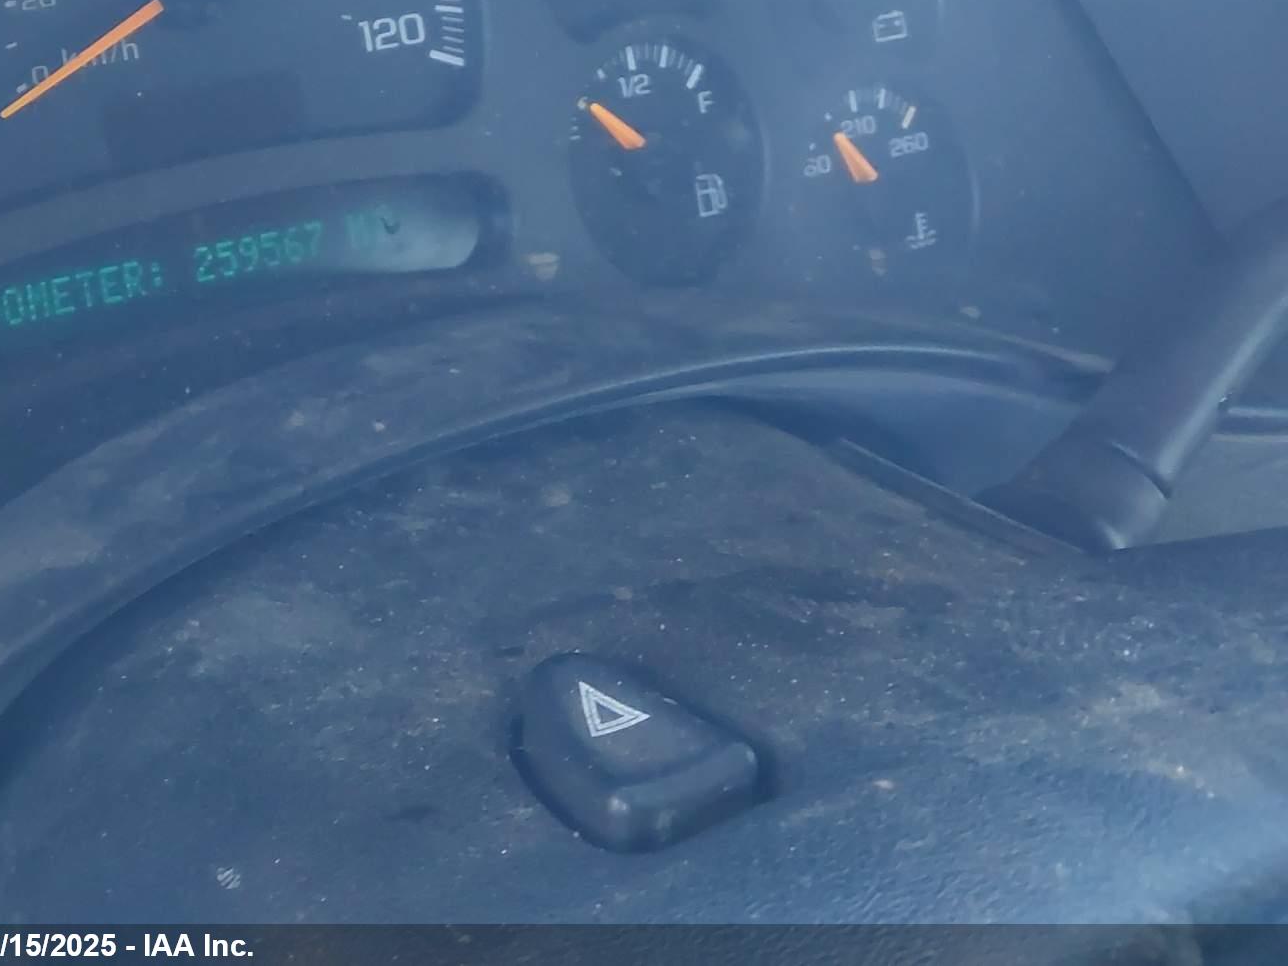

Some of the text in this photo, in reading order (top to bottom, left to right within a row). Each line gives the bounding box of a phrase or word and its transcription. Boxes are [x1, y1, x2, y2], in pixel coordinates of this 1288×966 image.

[358, 12, 426, 52] 120
[697, 89, 715, 113] F
[839, 115, 876, 138] 210
[888, 131, 930, 158] 260
[193, 219, 324, 284] 259567
